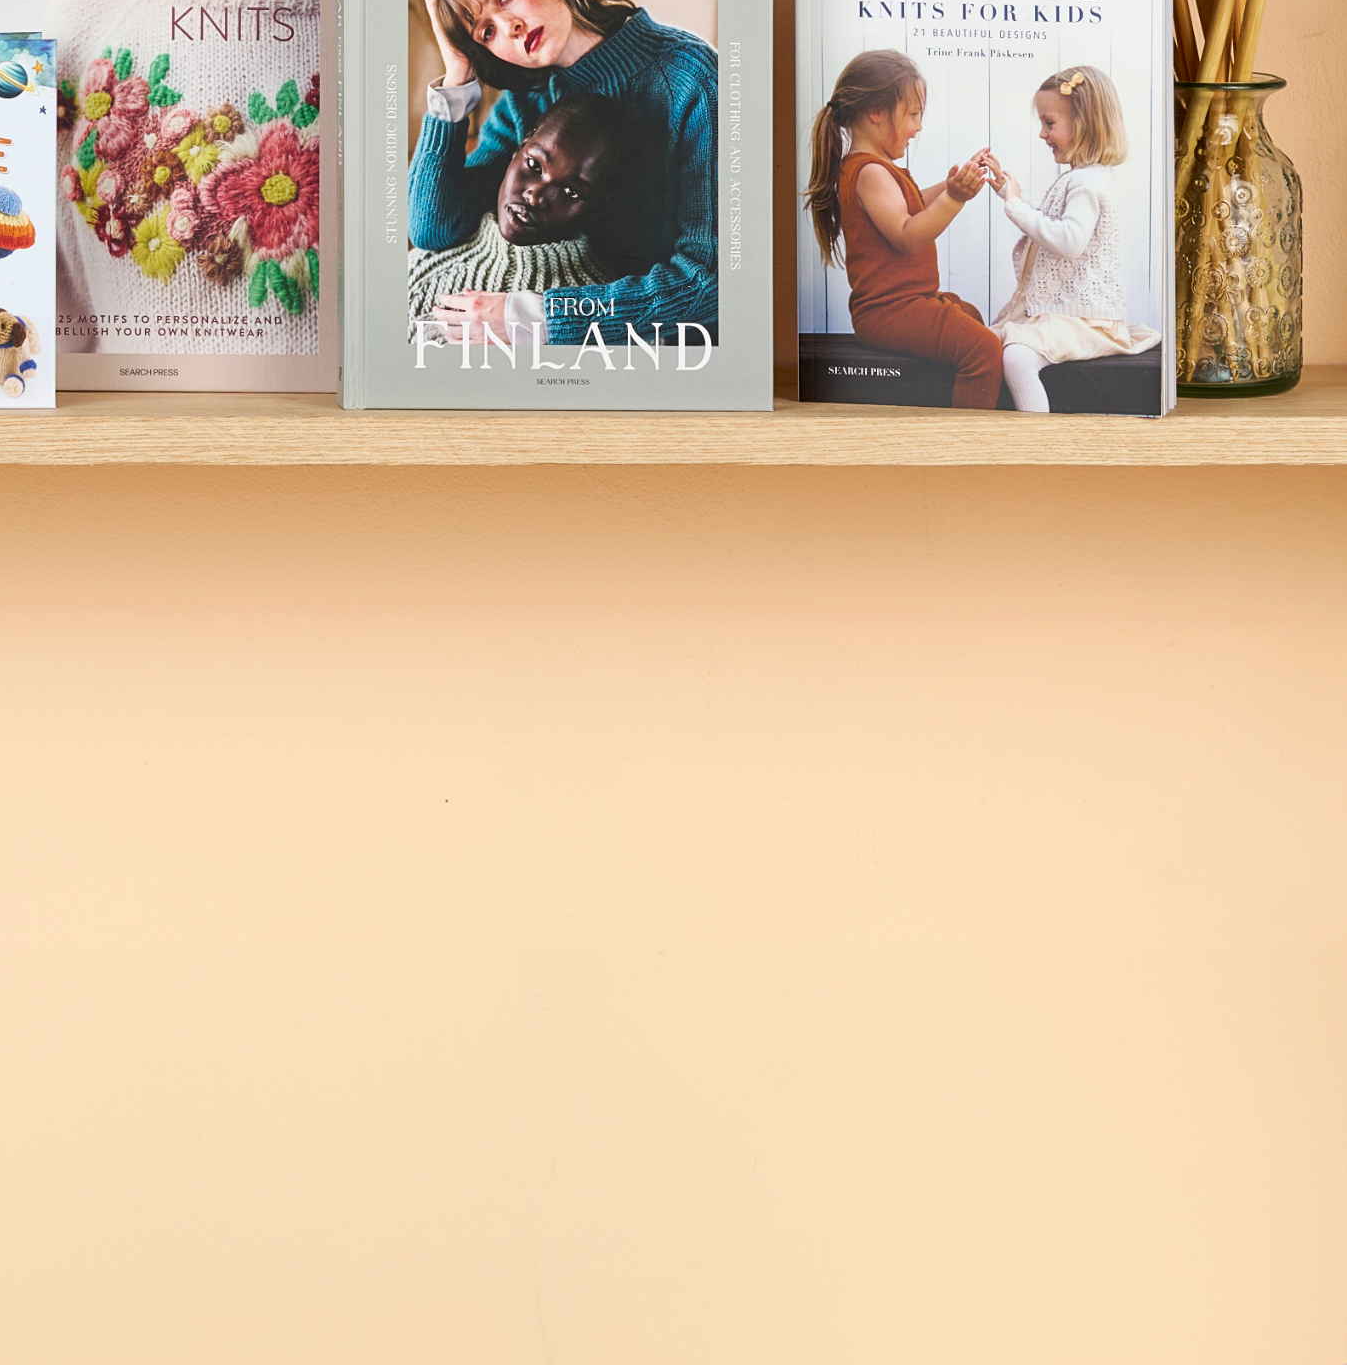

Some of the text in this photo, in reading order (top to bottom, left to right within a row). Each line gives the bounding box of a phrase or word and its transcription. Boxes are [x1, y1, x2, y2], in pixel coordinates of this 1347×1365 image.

[170, 6, 295, 42] KNITS
[858, 1, 1103, 24] KNITS FOR KIDS
[913, 28, 1048, 40] 21 BEAUTIFUL DESIGNS
[549, 298, 615, 317] FROM
[414, 321, 713, 371] FINLAND
